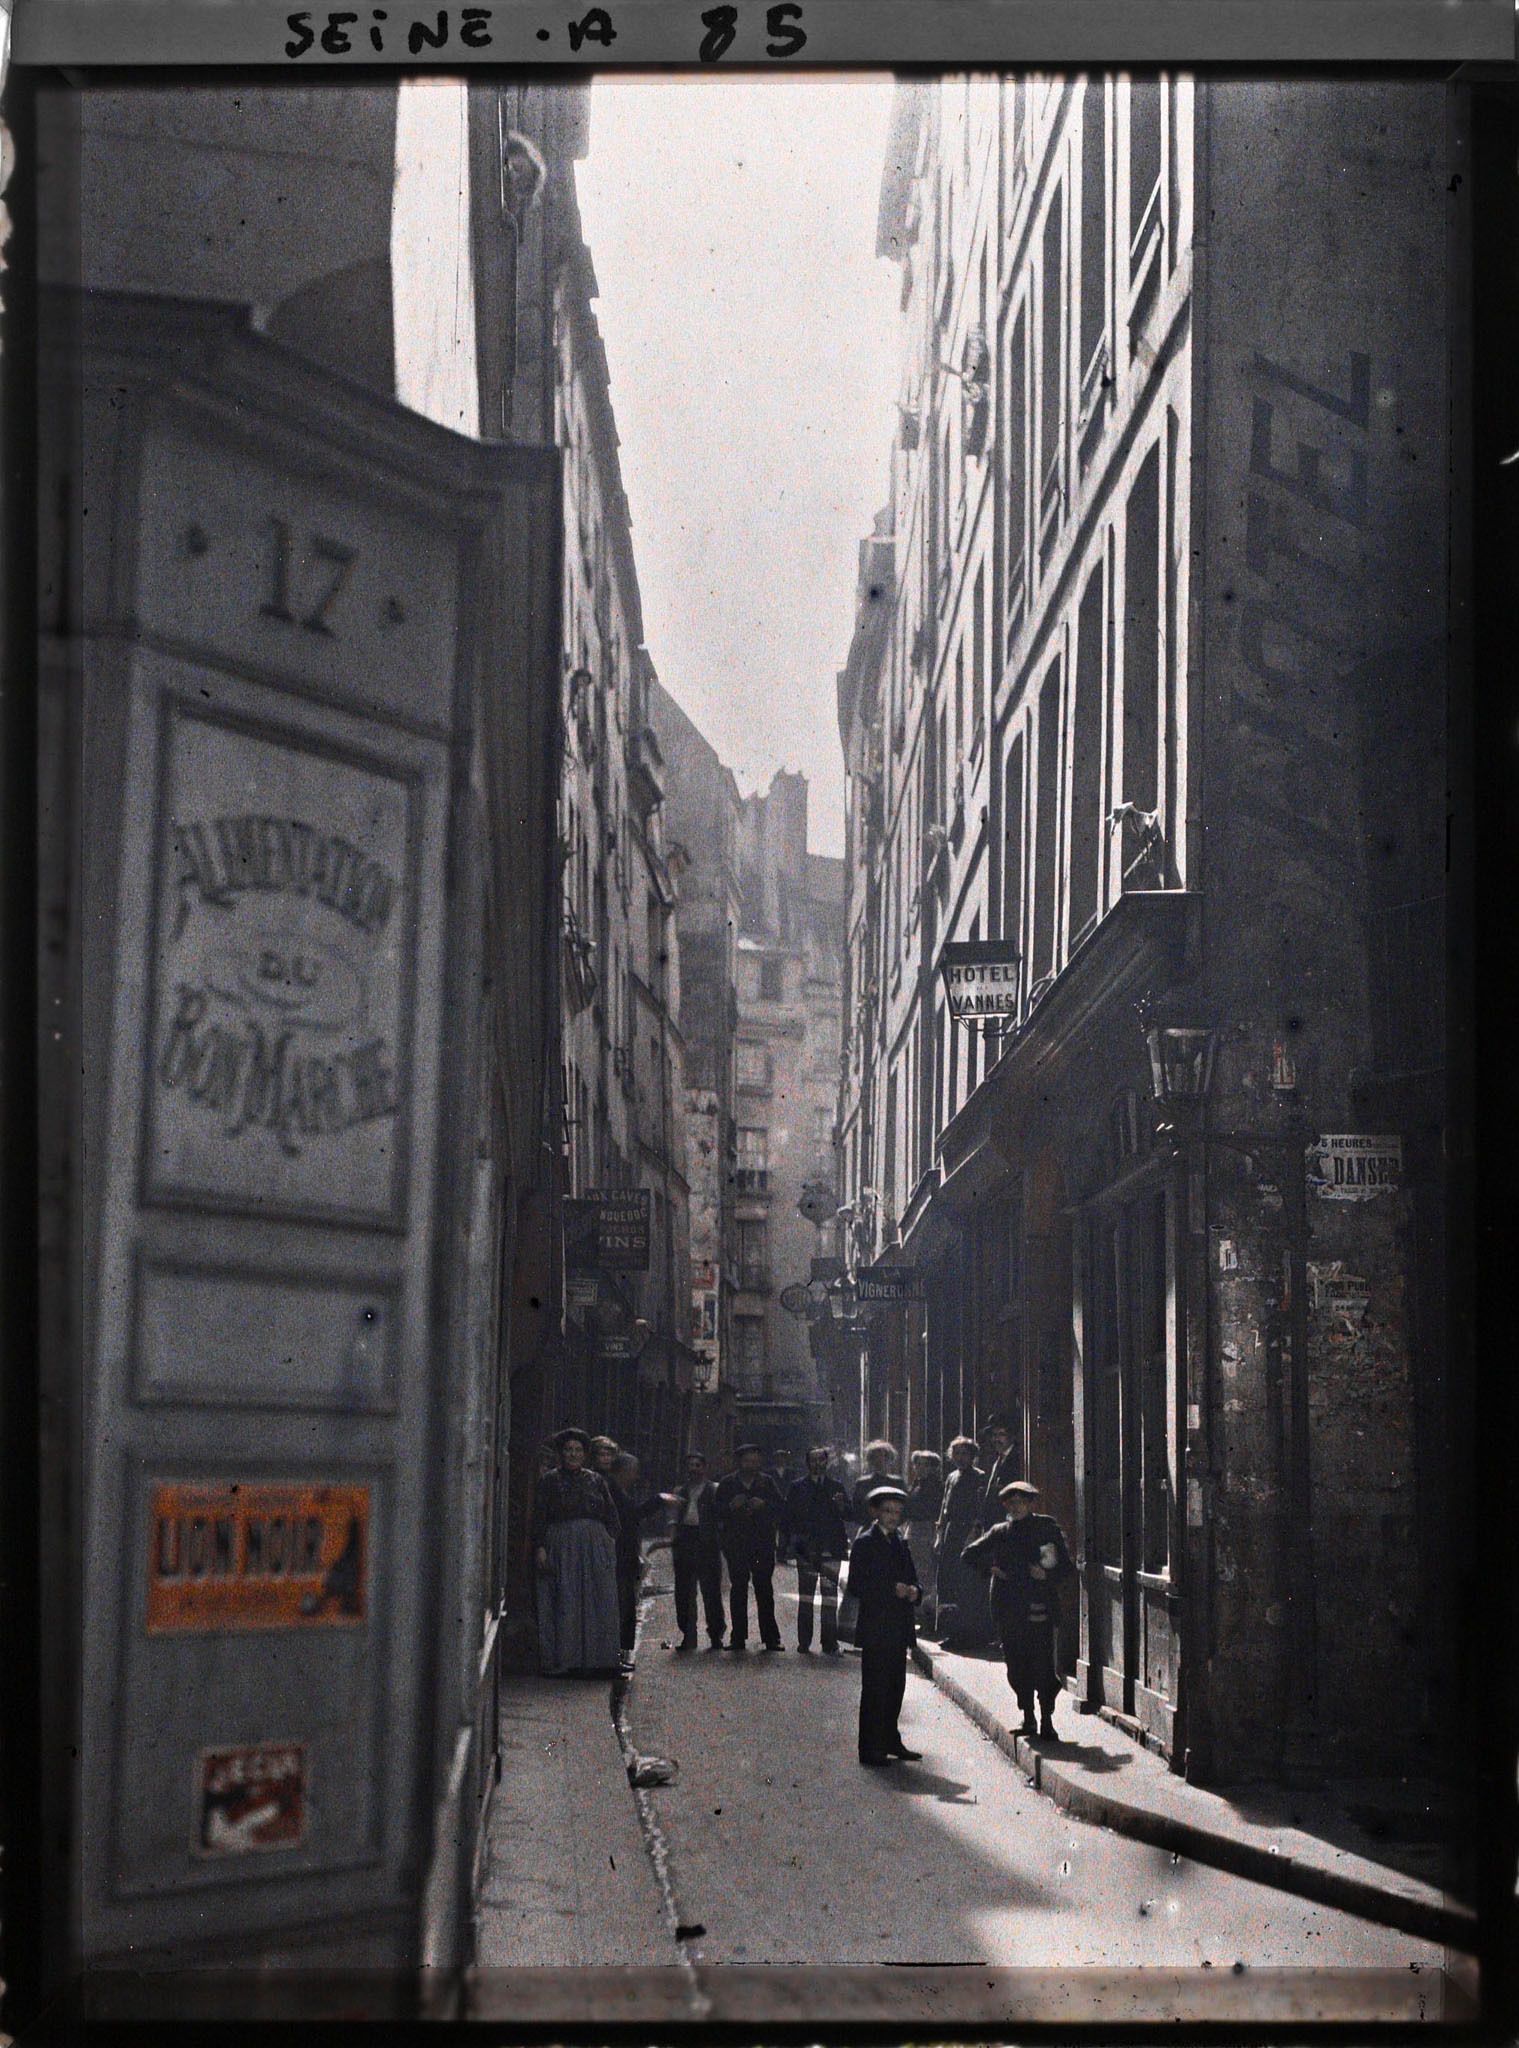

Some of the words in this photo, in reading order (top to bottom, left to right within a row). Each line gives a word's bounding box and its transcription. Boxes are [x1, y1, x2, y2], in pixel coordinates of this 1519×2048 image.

[259, 510, 360, 640] 17
[950, 966, 1014, 984] HOTEL
[952, 993, 1014, 1010] VANNES
[1331, 1138, 1372, 1149] HEURES
[611, 1189, 648, 1206] CAVES
[157, 1517, 235, 1577] LION
[243, 1515, 324, 1574] NOIR
